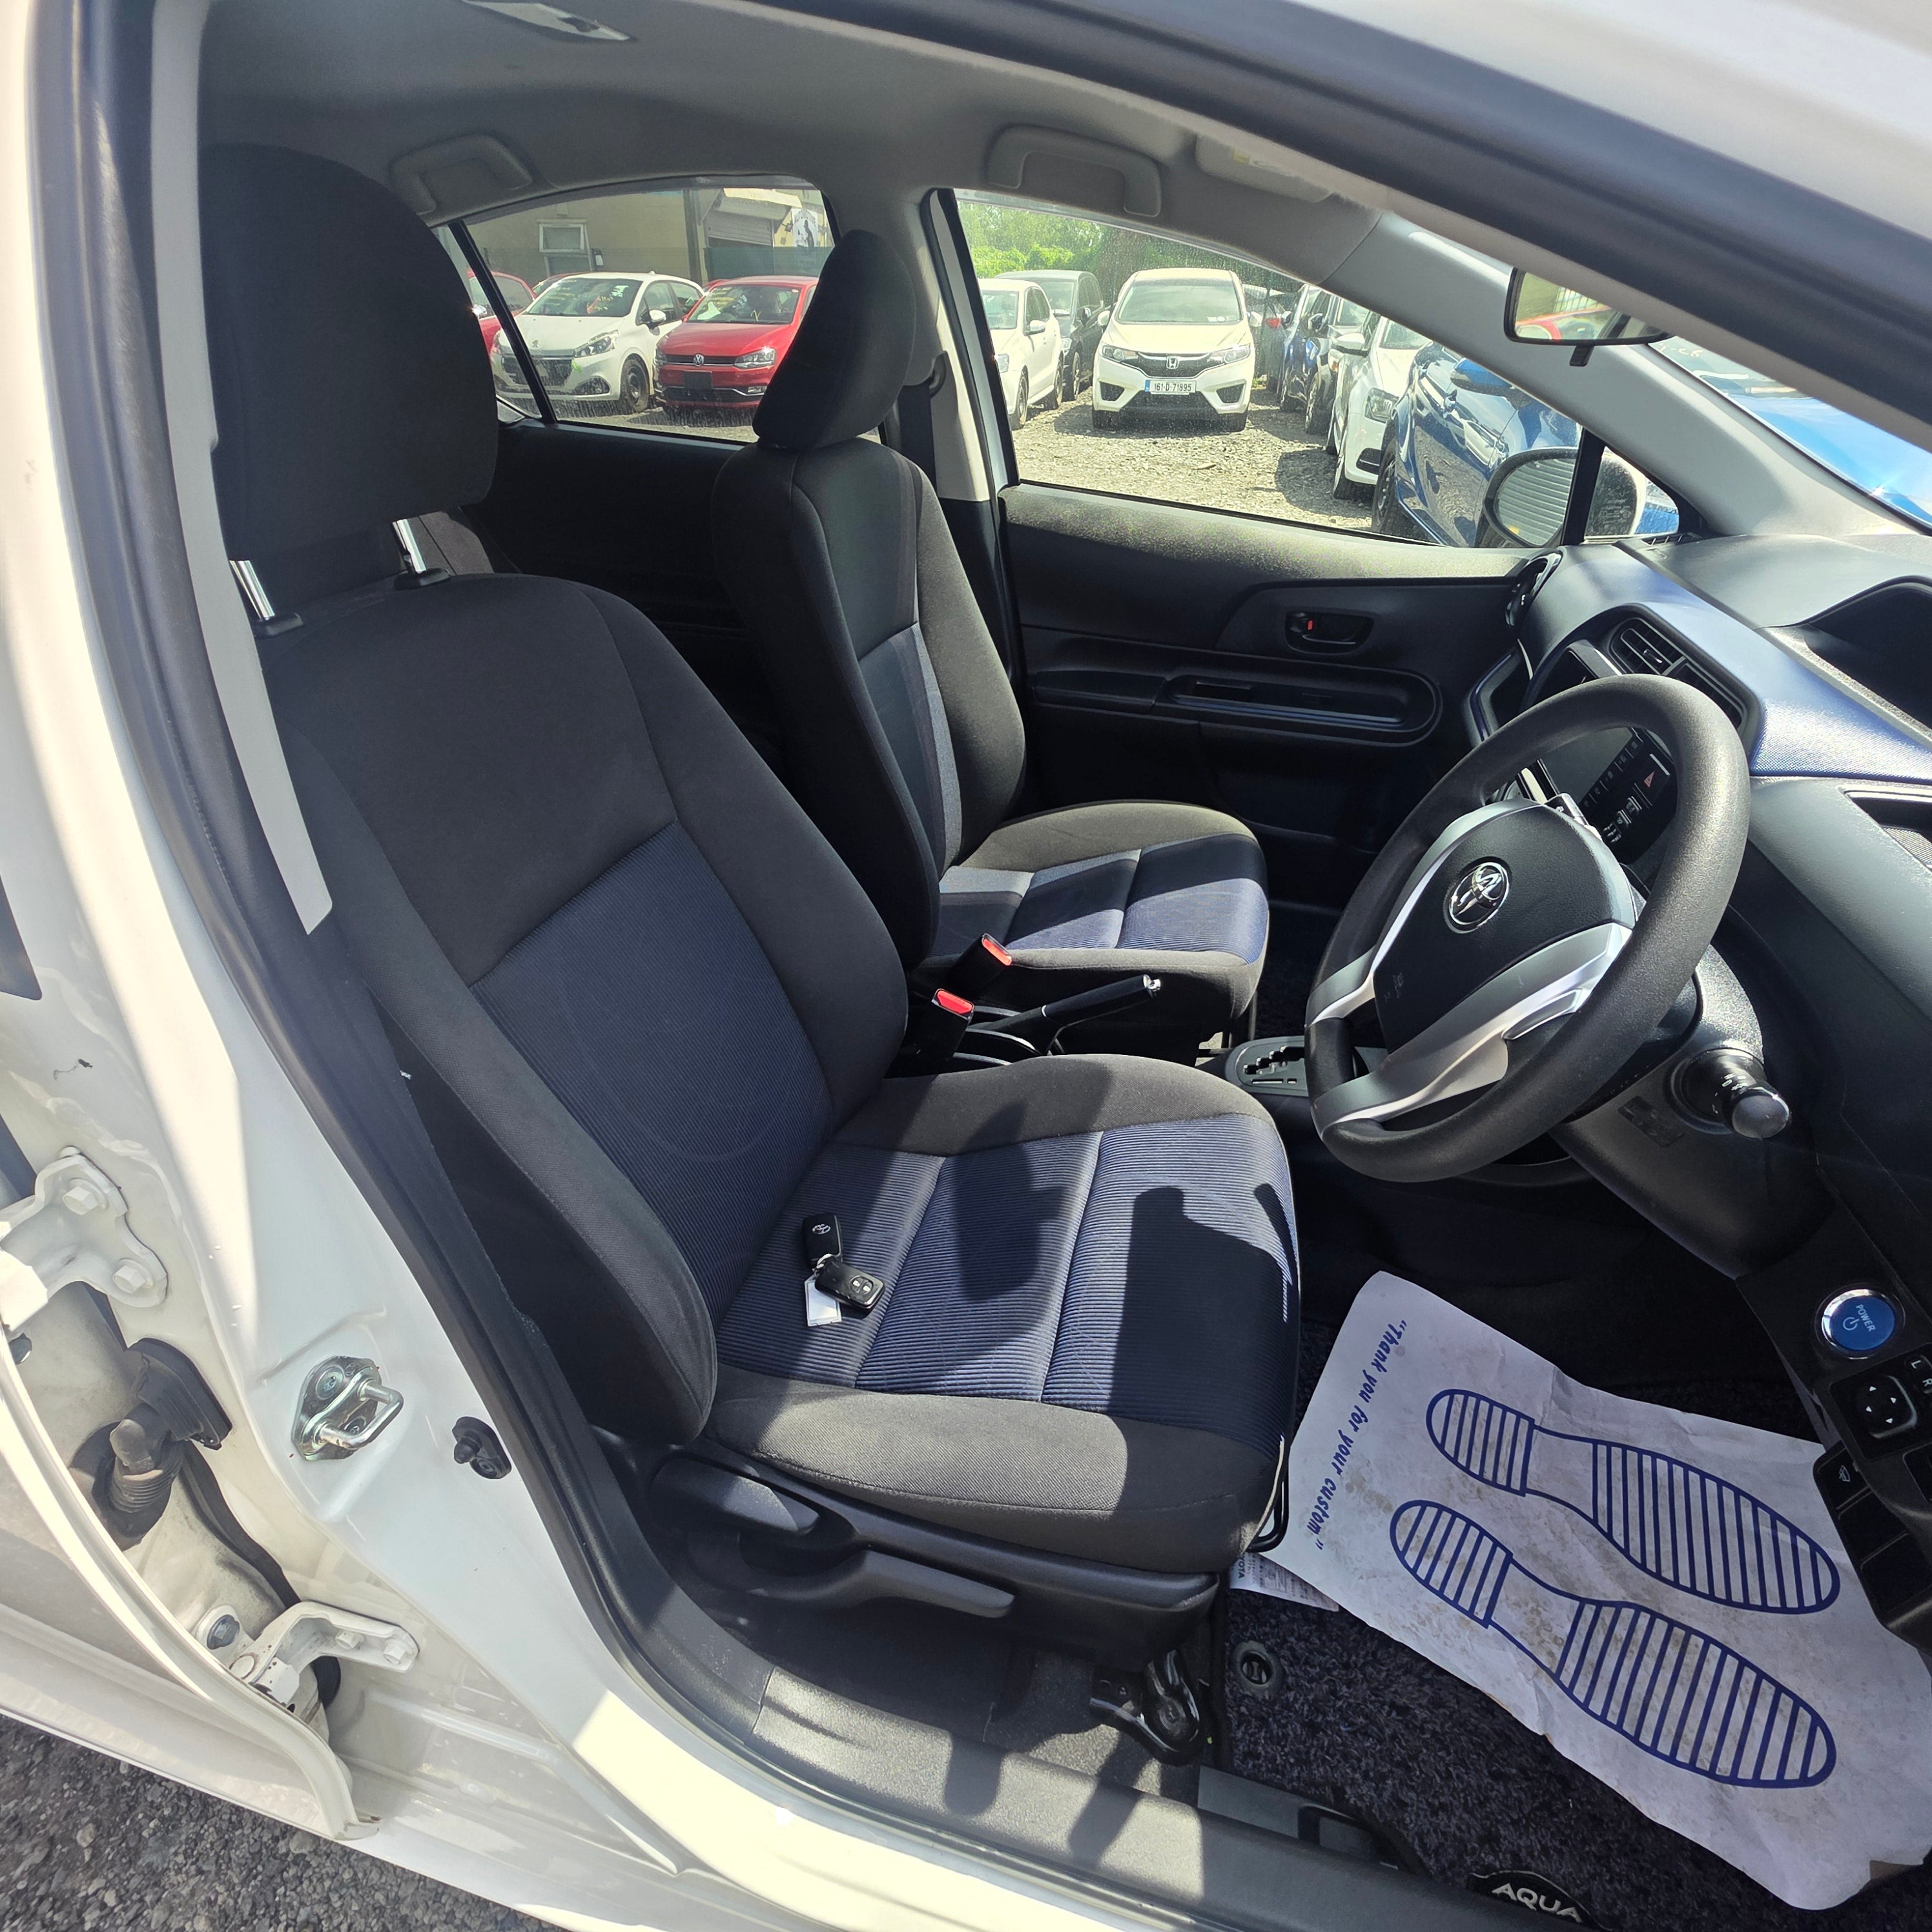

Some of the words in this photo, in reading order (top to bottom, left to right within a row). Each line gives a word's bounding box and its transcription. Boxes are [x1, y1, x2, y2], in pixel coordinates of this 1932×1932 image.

[1154, 382, 1192, 392] 161-D-71895
[1855, 1304, 1876, 1332] POWER
[1911, 1359, 1922, 1369] L
[1359, 1369, 1377, 1403] you
[1922, 1377, 1932, 1387] R
[1348, 1405, 1368, 1432] for
[1331, 1429, 1354, 1475] your
[1492, 1882, 1583, 1924] AQUA
